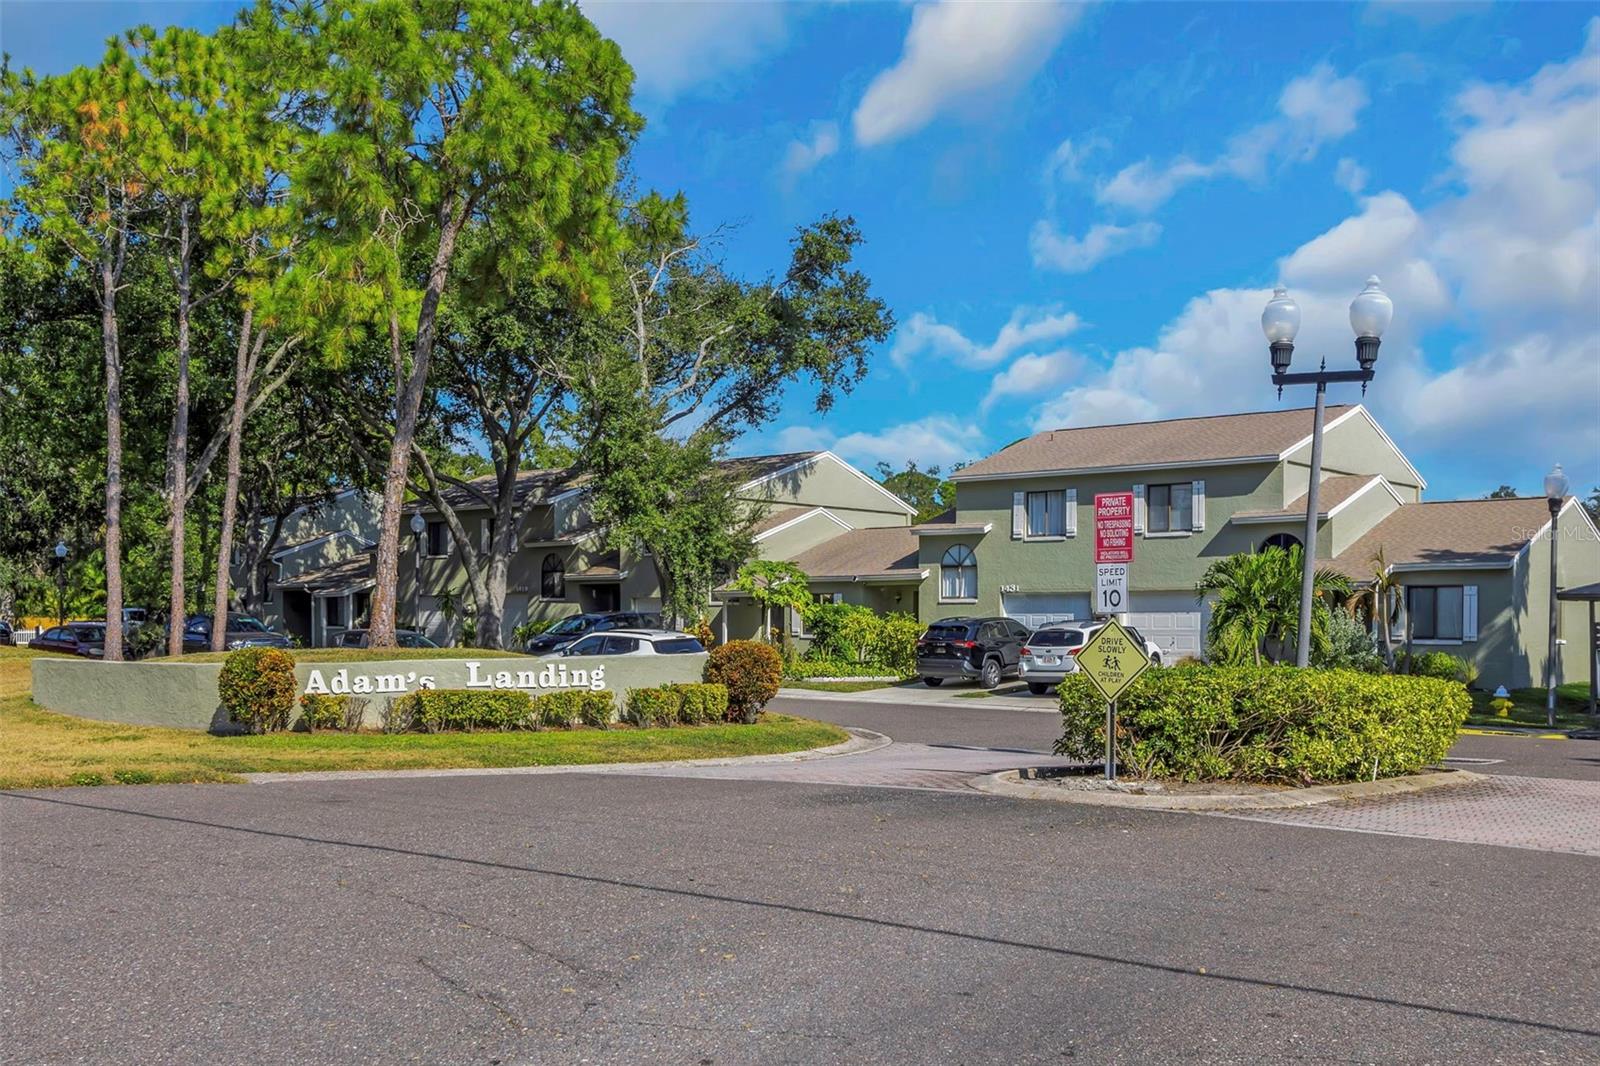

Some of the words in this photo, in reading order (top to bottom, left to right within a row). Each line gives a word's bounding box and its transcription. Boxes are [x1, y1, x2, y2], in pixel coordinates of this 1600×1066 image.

[1101, 496, 1127, 507] PRIVATE
[1097, 506, 1131, 516] PROPERTY
[1097, 521, 1104, 529] NO
[1098, 567, 1126, 577] SPEED
[1101, 578, 1122, 587] LIMIT
[1103, 589, 1121, 607] 10
[1101, 637, 1124, 646] DRIVE
[1097, 645, 1127, 654] SLOWLY
[304, 668, 436, 695] Adam's
[465, 661, 606, 691] Landing
[1097, 670, 1125, 678] CHILDREN
